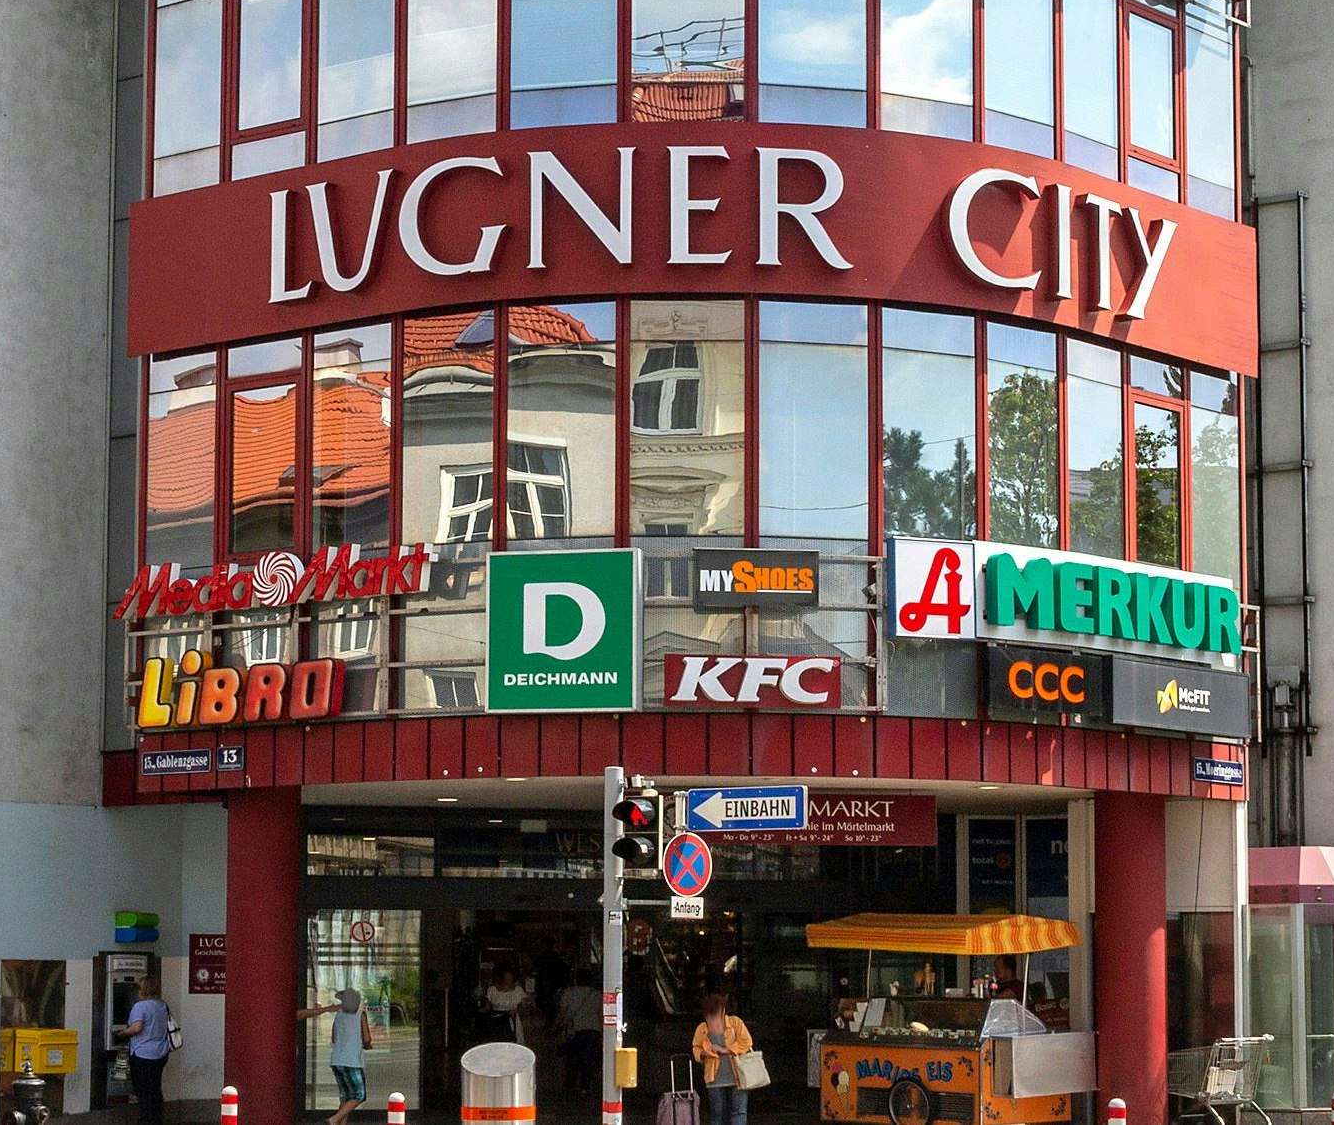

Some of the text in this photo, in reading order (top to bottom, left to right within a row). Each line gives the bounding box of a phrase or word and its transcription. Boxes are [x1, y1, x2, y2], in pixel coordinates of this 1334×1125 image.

[268, 145, 1177, 321] LUGNER CITY
[113, 542, 438, 619] Media Markt
[987, 552, 1242, 654] MERKUR
[524, 582, 606, 661] D
[503, 671, 618, 688] DEICHMANN
[669, 656, 835, 705] KFC
[1008, 661, 1085, 704] CCC
[1178, 687, 1211, 705] McFIT
[156, 755, 208, 770] Gablenzgasse
[223, 750, 238, 763] 13
[724, 798, 791, 818] EINBAHN
[822, 821, 895, 832] im Mörtelmarkt
[675, 901, 700, 916] Anfang
[926, 1061, 953, 1081] EIS
